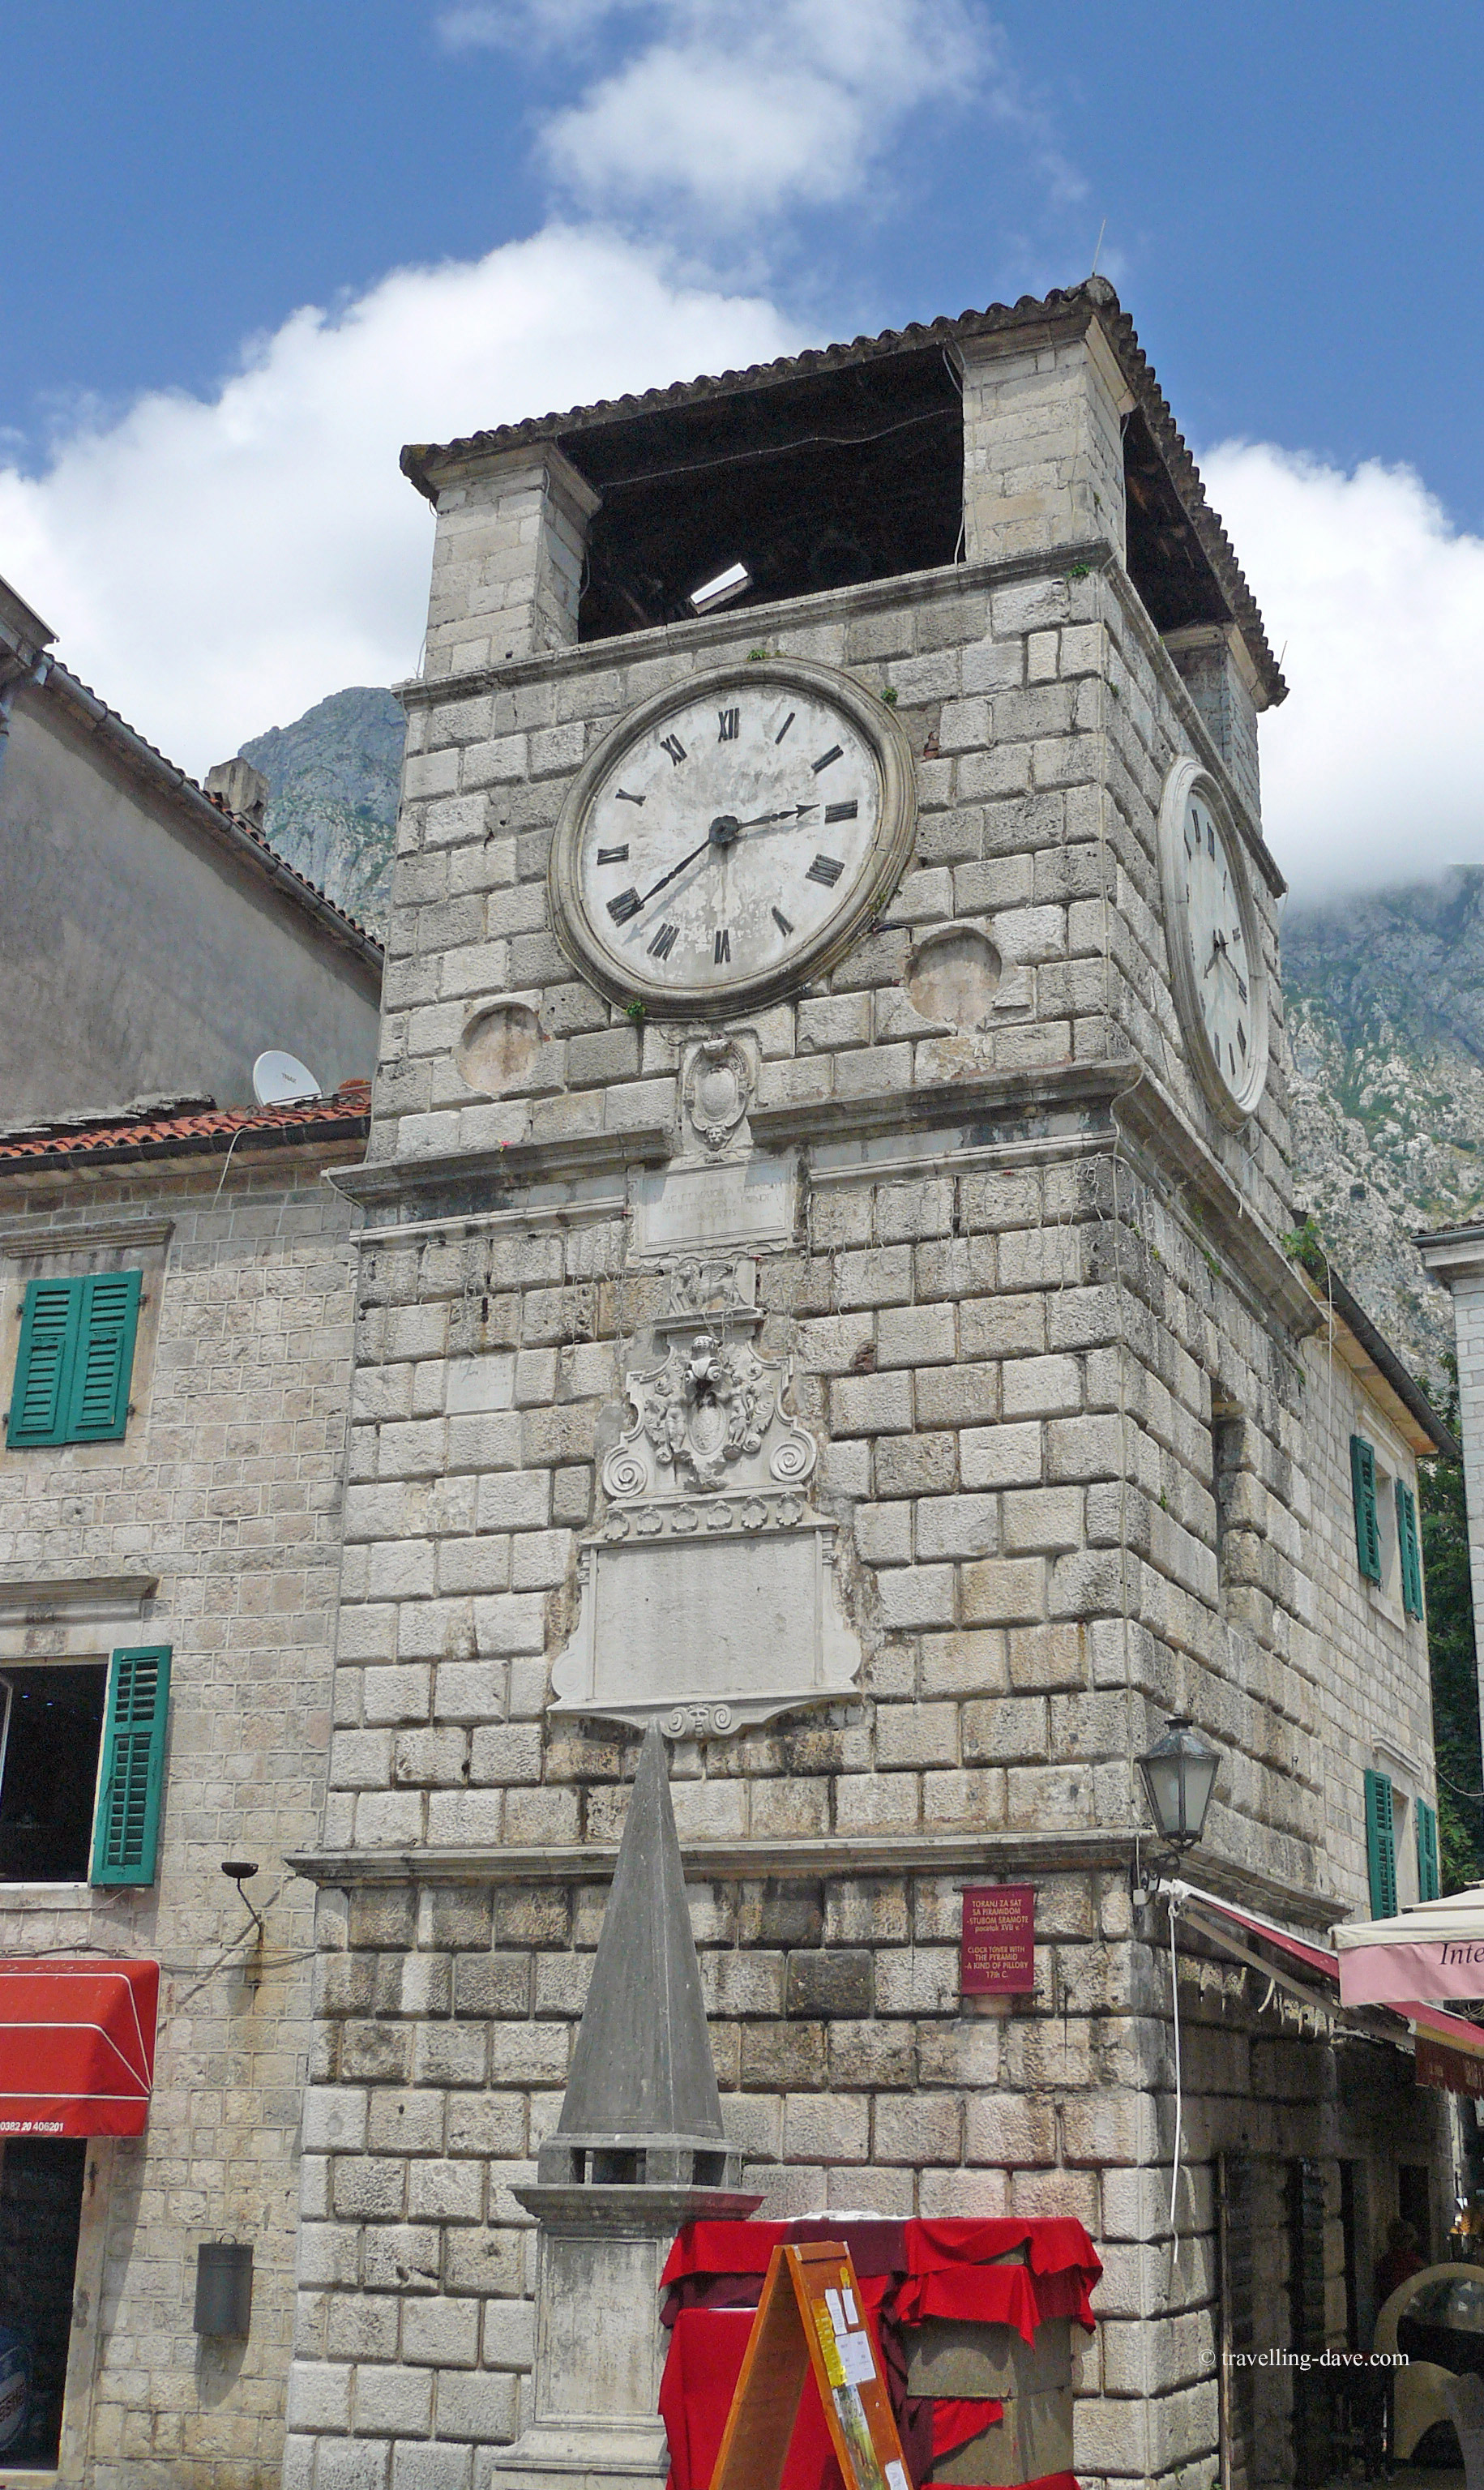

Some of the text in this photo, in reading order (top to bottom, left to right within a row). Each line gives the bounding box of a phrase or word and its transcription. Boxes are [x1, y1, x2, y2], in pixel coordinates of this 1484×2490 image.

[718, 708, 739, 743] XII
[775, 712, 795, 744] I
[660, 734, 687, 767] XI
[811, 745, 844, 774] II
[615, 788, 646, 806] X
[824, 799, 858, 824] III
[597, 843, 629, 865] IX
[772, 905, 793, 938] V
[647, 922, 680, 961] VII
[715, 929, 730, 964] VI
[982, 1907, 1021, 1915] PIRAMIDOM
[0, 2121, 20, 2131] 0382
[21, 2121, 32, 2131] 20
